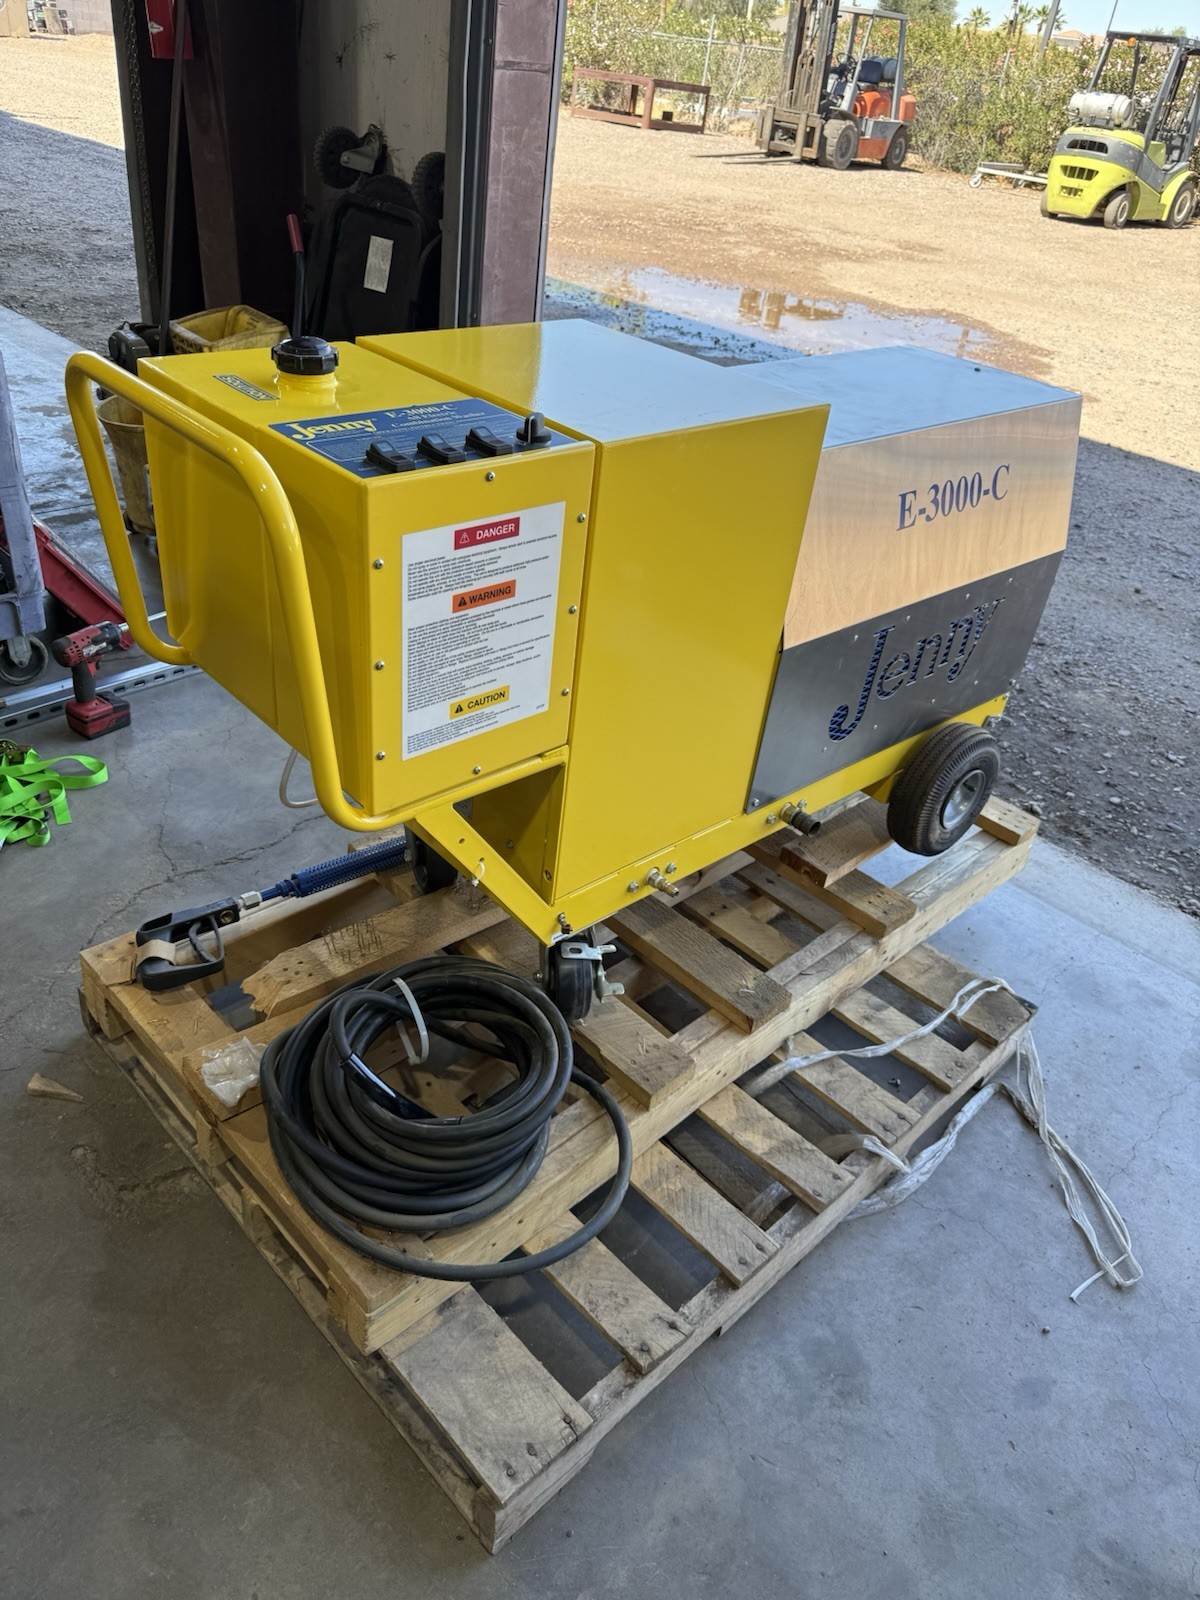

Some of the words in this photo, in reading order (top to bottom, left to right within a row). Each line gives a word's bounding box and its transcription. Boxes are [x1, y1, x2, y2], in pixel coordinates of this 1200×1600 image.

[286, 418, 378, 441] Jenny
[896, 464, 1011, 531] E-3000-C
[476, 522, 516, 540] DANGER
[469, 585, 512, 605] WARNING
[827, 596, 1006, 742] Jenny
[467, 690, 507, 710] CAUTION
